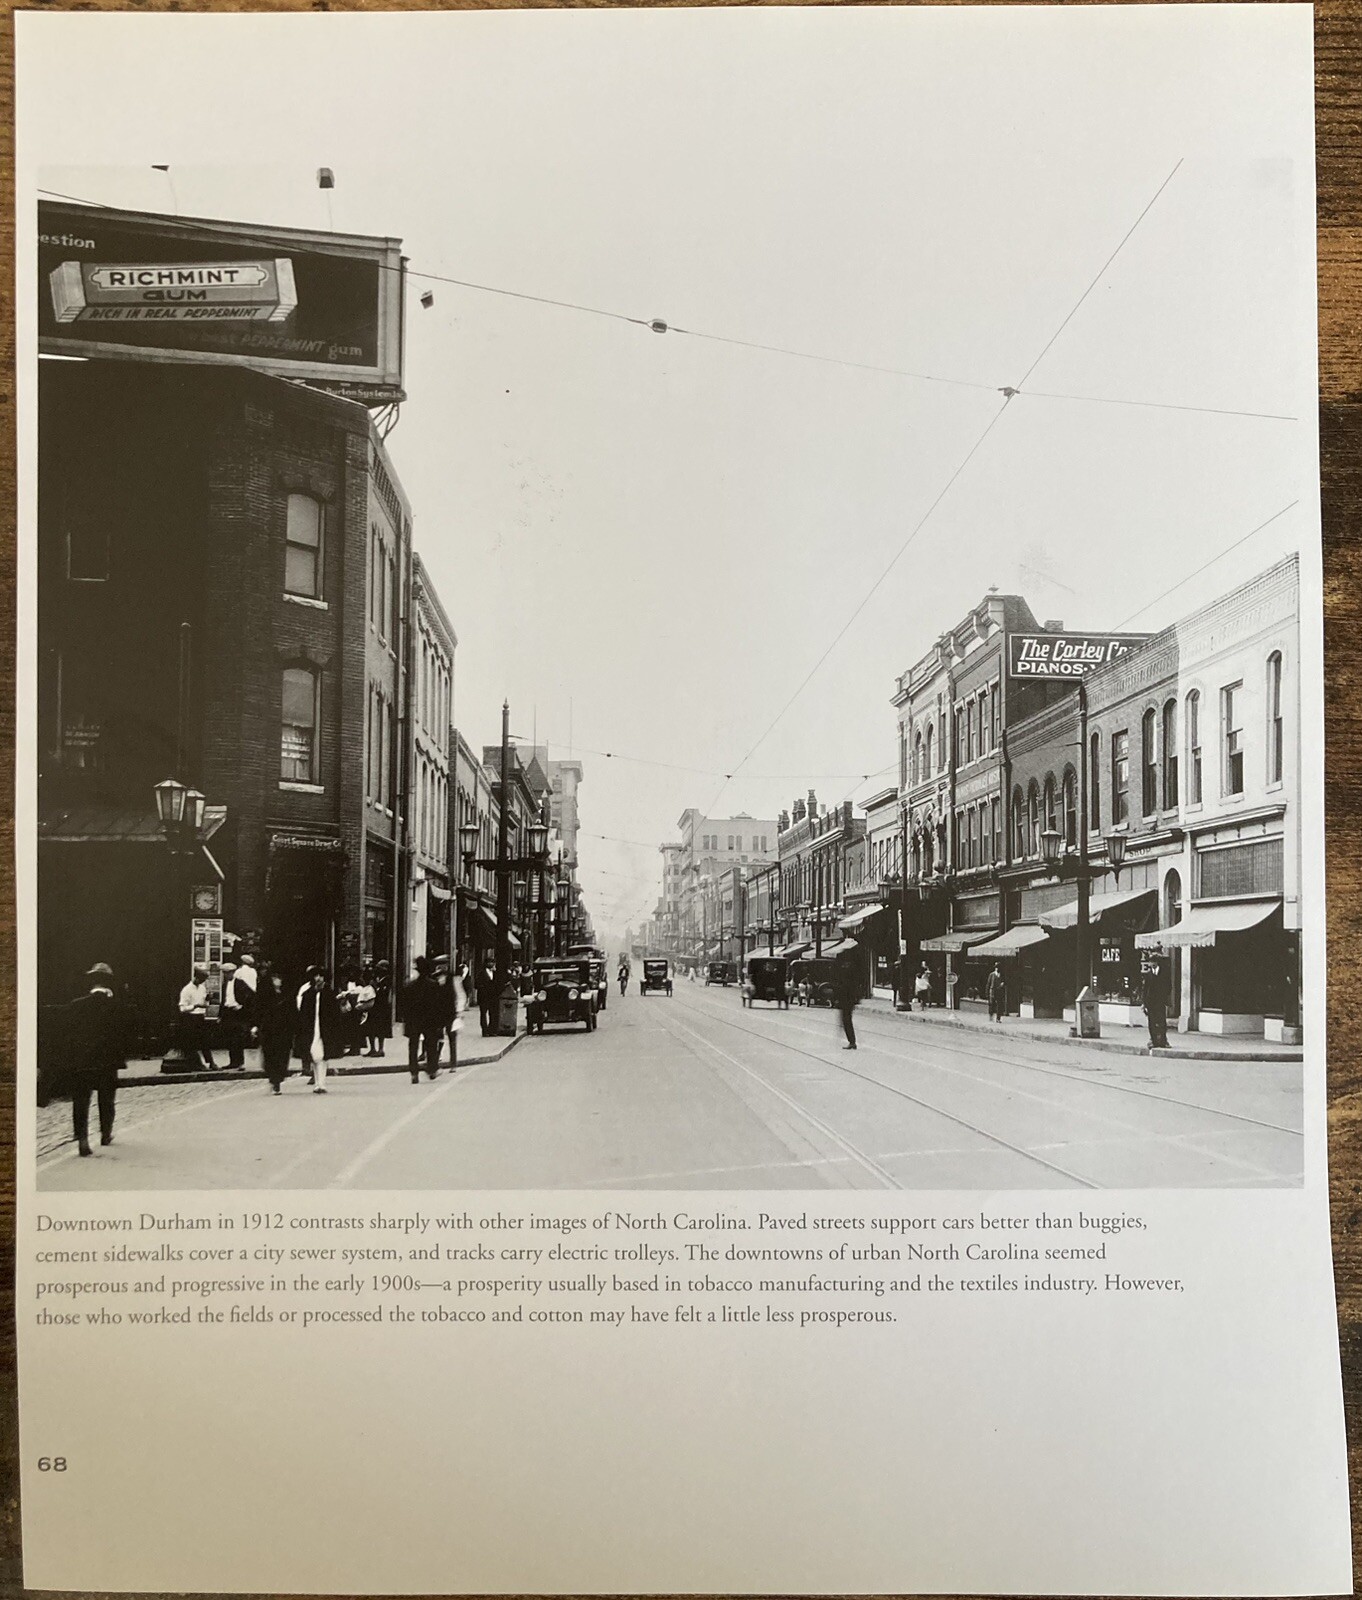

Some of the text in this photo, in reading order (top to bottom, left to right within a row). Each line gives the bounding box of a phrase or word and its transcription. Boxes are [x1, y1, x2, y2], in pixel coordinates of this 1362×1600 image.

[38, 233, 96, 249] estion
[109, 269, 239, 285] RICHMINT
[143, 289, 207, 301] GUM
[89, 306, 261, 319] RICH IN REAL PEPPERMINT
[241, 334, 326, 353] PEPPERMINT
[327, 343, 363, 361] gum
[1019, 638, 1050, 660] The
[1052, 640, 1104, 663] Corley
[1101, 948, 1121, 962] CAFE
[36, 1211, 1148, 1235] Downtown Durham in 1912 contrasts sharply with other images of North Carolina. Paved streets support cars better than buggies,
[35, 1241, 1107, 1266] cement sidewalks cover a city sewer system, and tracks carry electric trolleys. The downtowns of urban North Carolina seemed
[35, 1281, 129, 1300] prosperous
[133, 1274, 166, 1294] and
[171, 1274, 265, 1298] progressive
[270, 1274, 287, 1292] in
[292, 1273, 320, 1292] the
[324, 1273, 366, 1297] early
[457, 1274, 543, 1297] prosperity
[548, 1273, 608, 1297] usually
[612, 1273, 660, 1292] based
[665, 1274, 682, 1292] in
[687, 1273, 753, 1292] tobacco
[758, 1273, 886, 1298] manufacturing
[889, 1273, 922, 1292] and
[927, 1273, 955, 1292] the
[960, 1273, 1019, 1292] textiles
[1024, 1273, 1098, 1296] industry.
[1104, 1273, 1185, 1293] However,
[36, 1304, 897, 1328] those who worked the fields or processed the tobacco and cotton may have felt a little less prosperous.
[37, 1456, 68, 1472] 68
